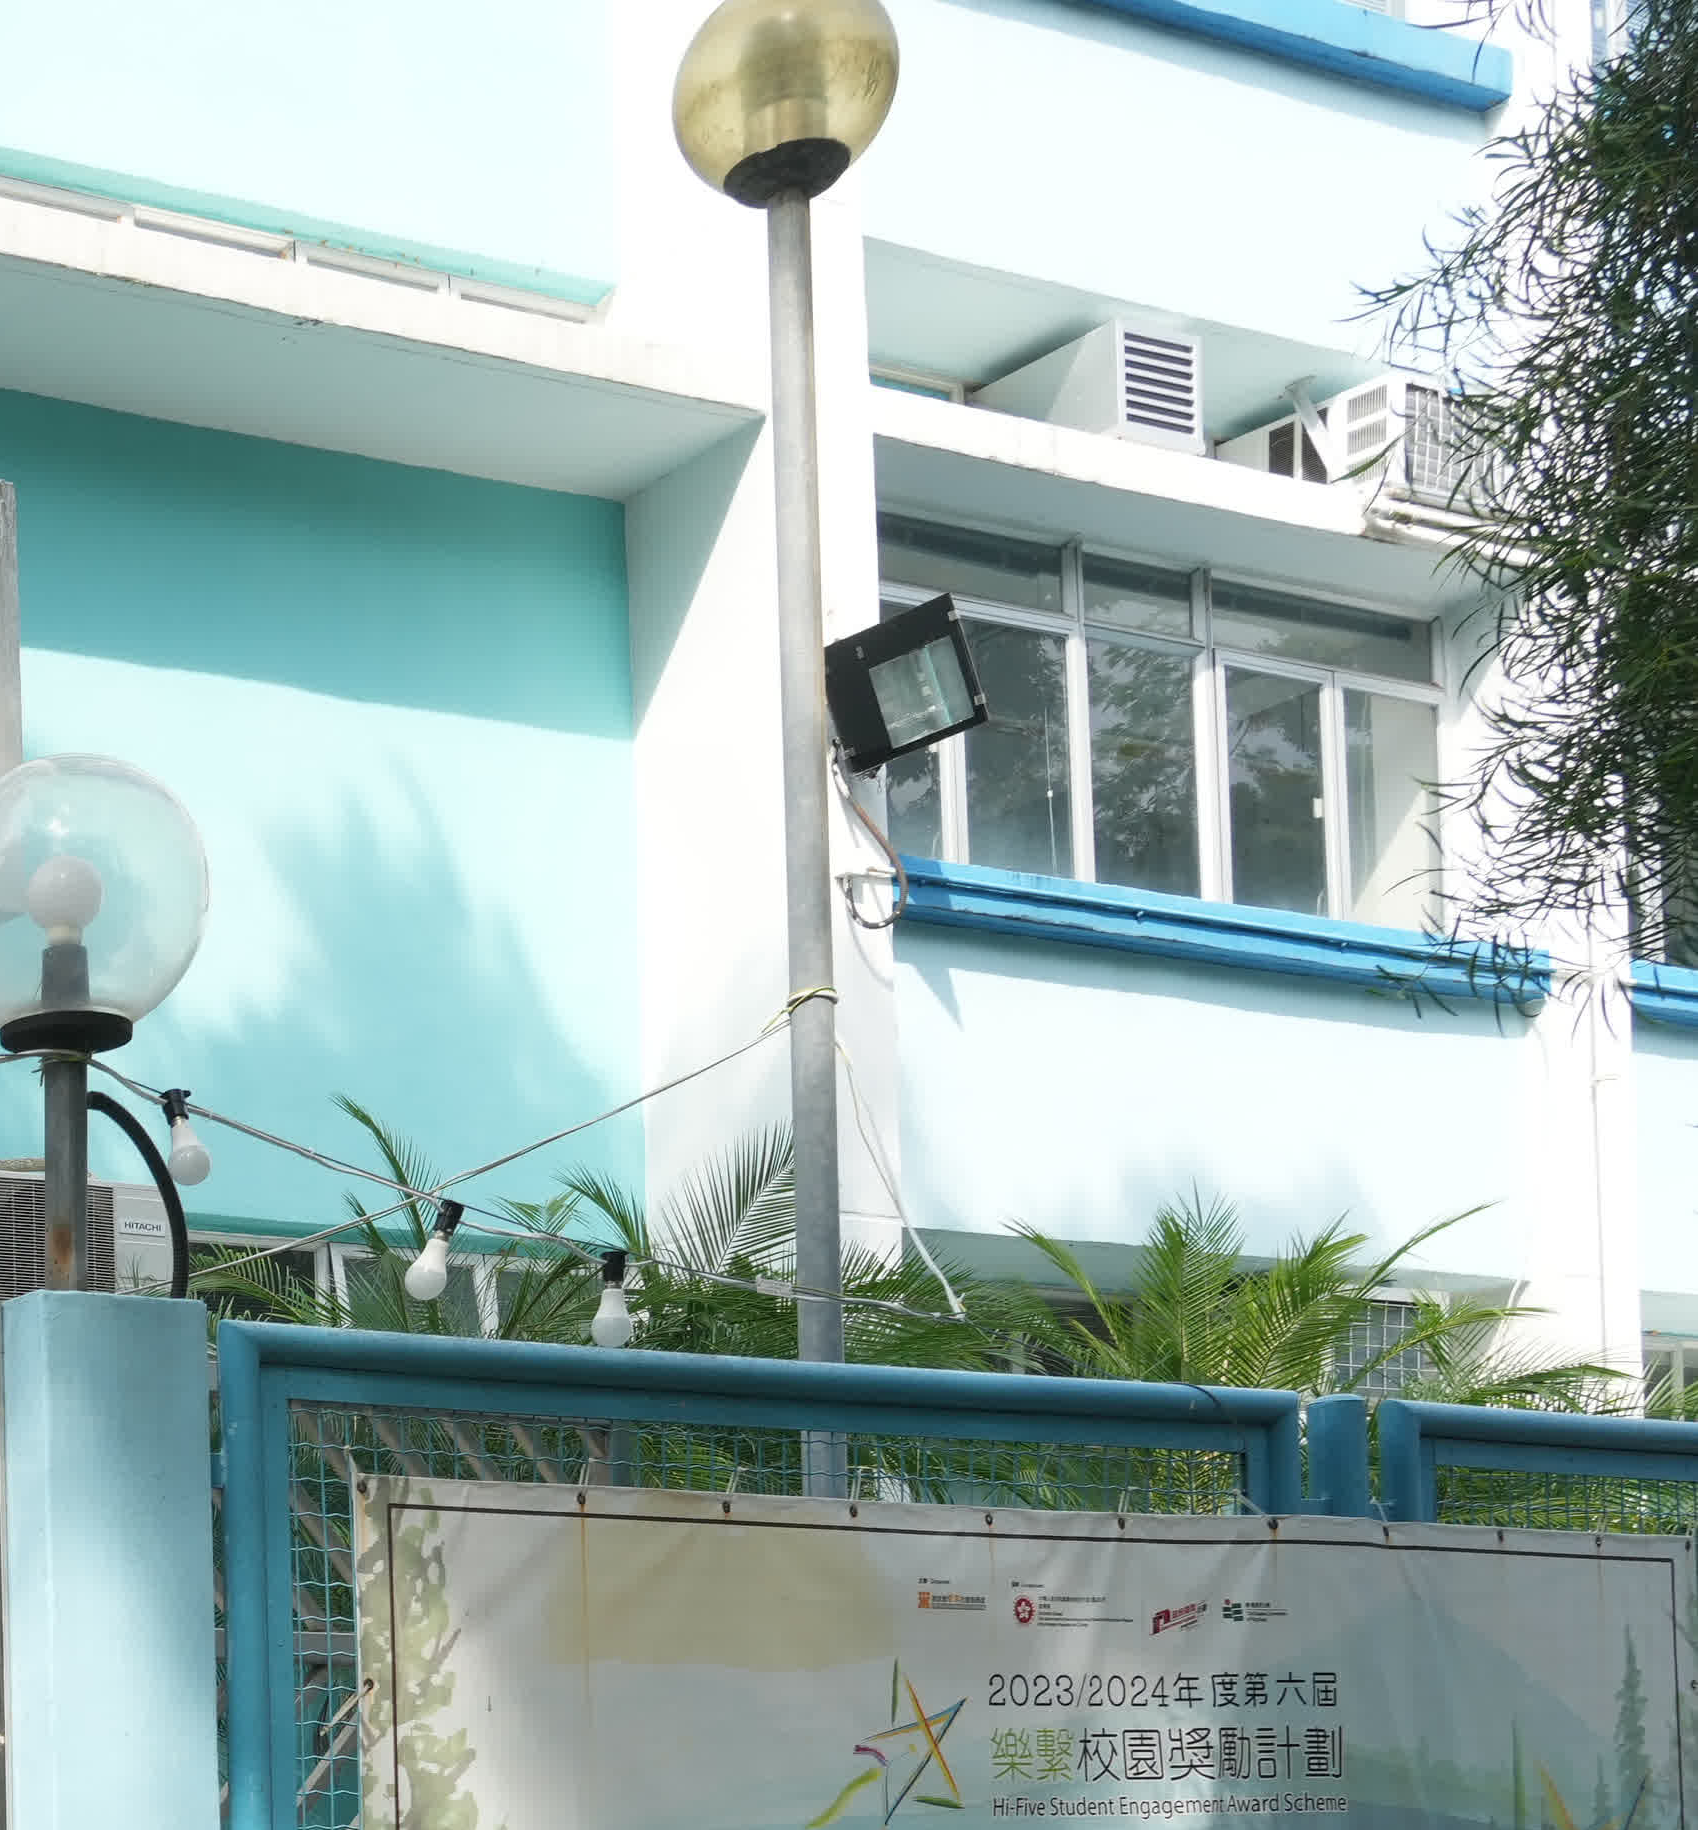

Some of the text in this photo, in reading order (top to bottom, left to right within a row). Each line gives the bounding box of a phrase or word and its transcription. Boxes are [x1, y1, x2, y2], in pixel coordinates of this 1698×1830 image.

[124, 1221, 162, 1231] HITACHI
[987, 1671, 1340, 1710] 2023/2024年度第六屆
[992, 1794, 1348, 1821] Hi-Five Student Engagement Award Scheme
